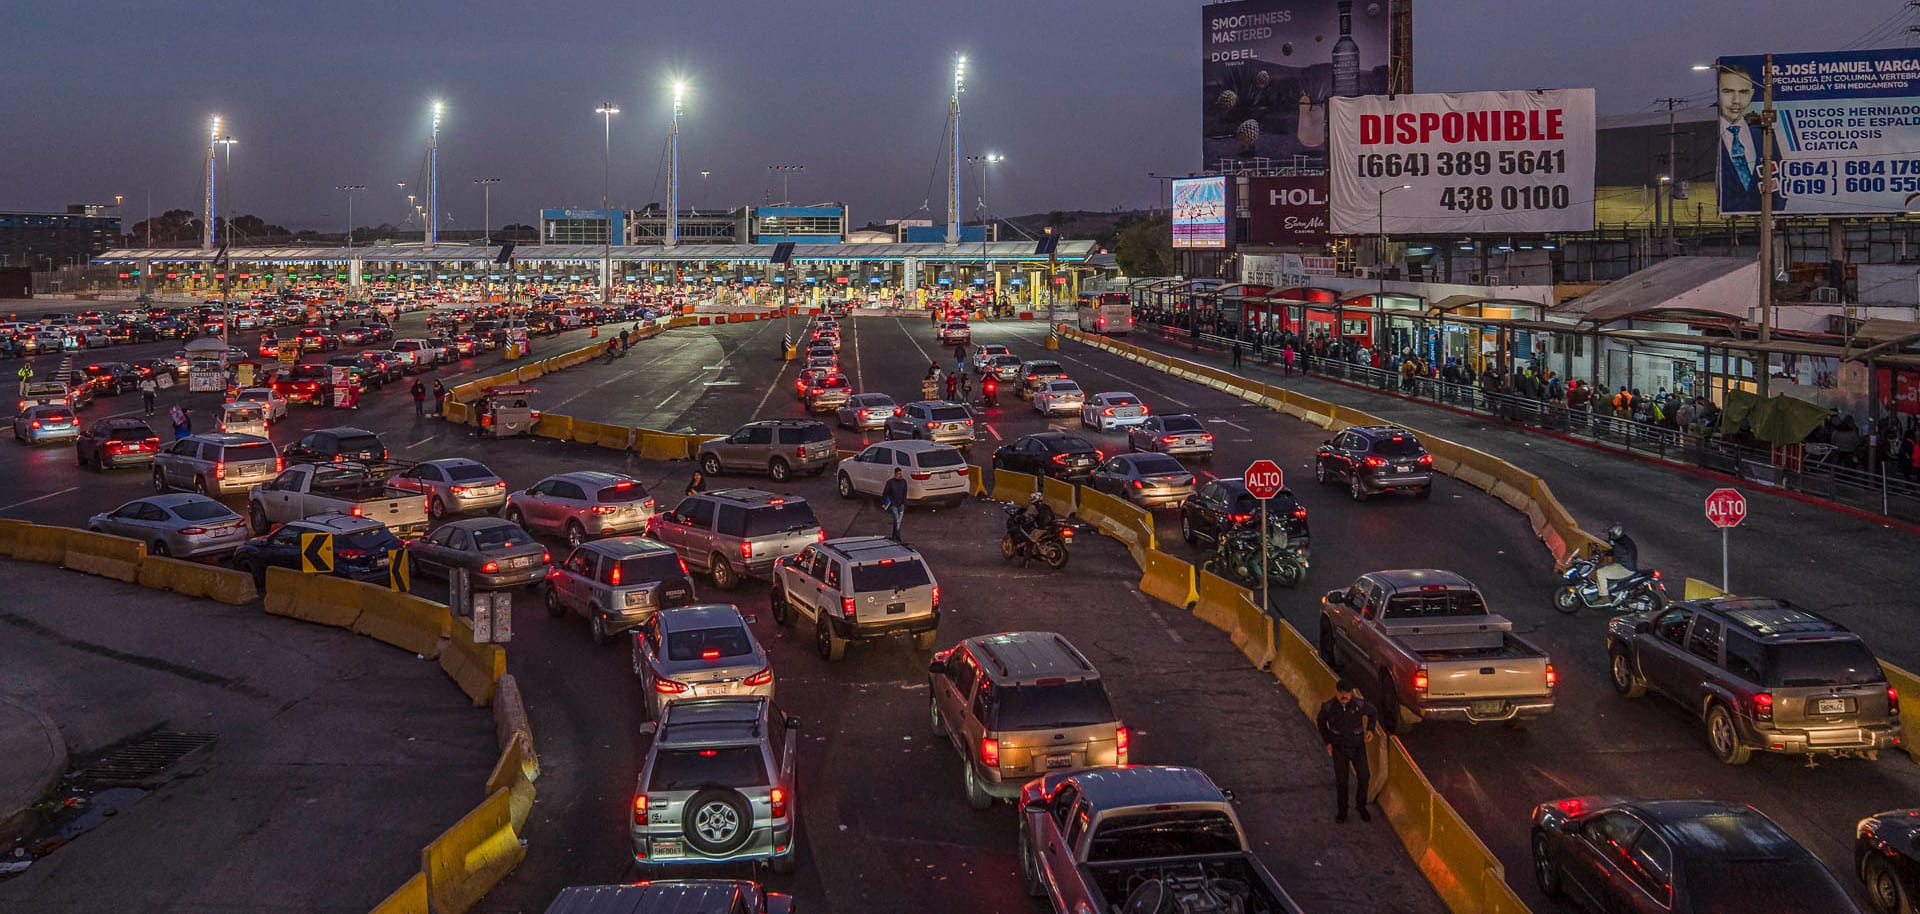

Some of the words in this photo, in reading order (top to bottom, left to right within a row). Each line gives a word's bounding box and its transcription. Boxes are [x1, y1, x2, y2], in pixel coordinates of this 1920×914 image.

[1212, 10, 1292, 30] SMOOTHNESS
[1212, 27, 1272, 44] MASTERED
[1211, 48, 1258, 62] DOBEL
[1762, 65, 1783, 76] R.
[1785, 60, 1816, 76] JOSÉ
[1818, 61, 1873, 74] MANUEL
[1821, 75, 1832, 83] EN
[1834, 74, 1878, 82] COLUMNA
[1781, 84, 1793, 92] SIN
[1794, 83, 1825, 92] CIRUGÍA
[1847, 81, 1908, 90] MEDICAMENTOS
[1795, 107, 1845, 118] DISCOS
[1360, 108, 1564, 145] DISPONIBLE
[1798, 118, 1844, 128] DOLOR
[1847, 118, 1865, 127] DE
[1801, 129, 1882, 140] ESCOLIOSIS
[1805, 140, 1858, 151] CIATICA
[1357, 152, 1430, 178] (664)
[1437, 151, 1491, 175] 389
[1499, 149, 1565, 174] 5641
[1845, 160, 1886, 175] 684
[1845, 177, 1885, 192] 600
[1270, 188, 1328, 206] HOL
[1440, 186, 1493, 212] 438
[1501, 184, 1569, 210] 0100
[1248, 472, 1280, 487] ALTO
[1709, 500, 1744, 515] ALTO
